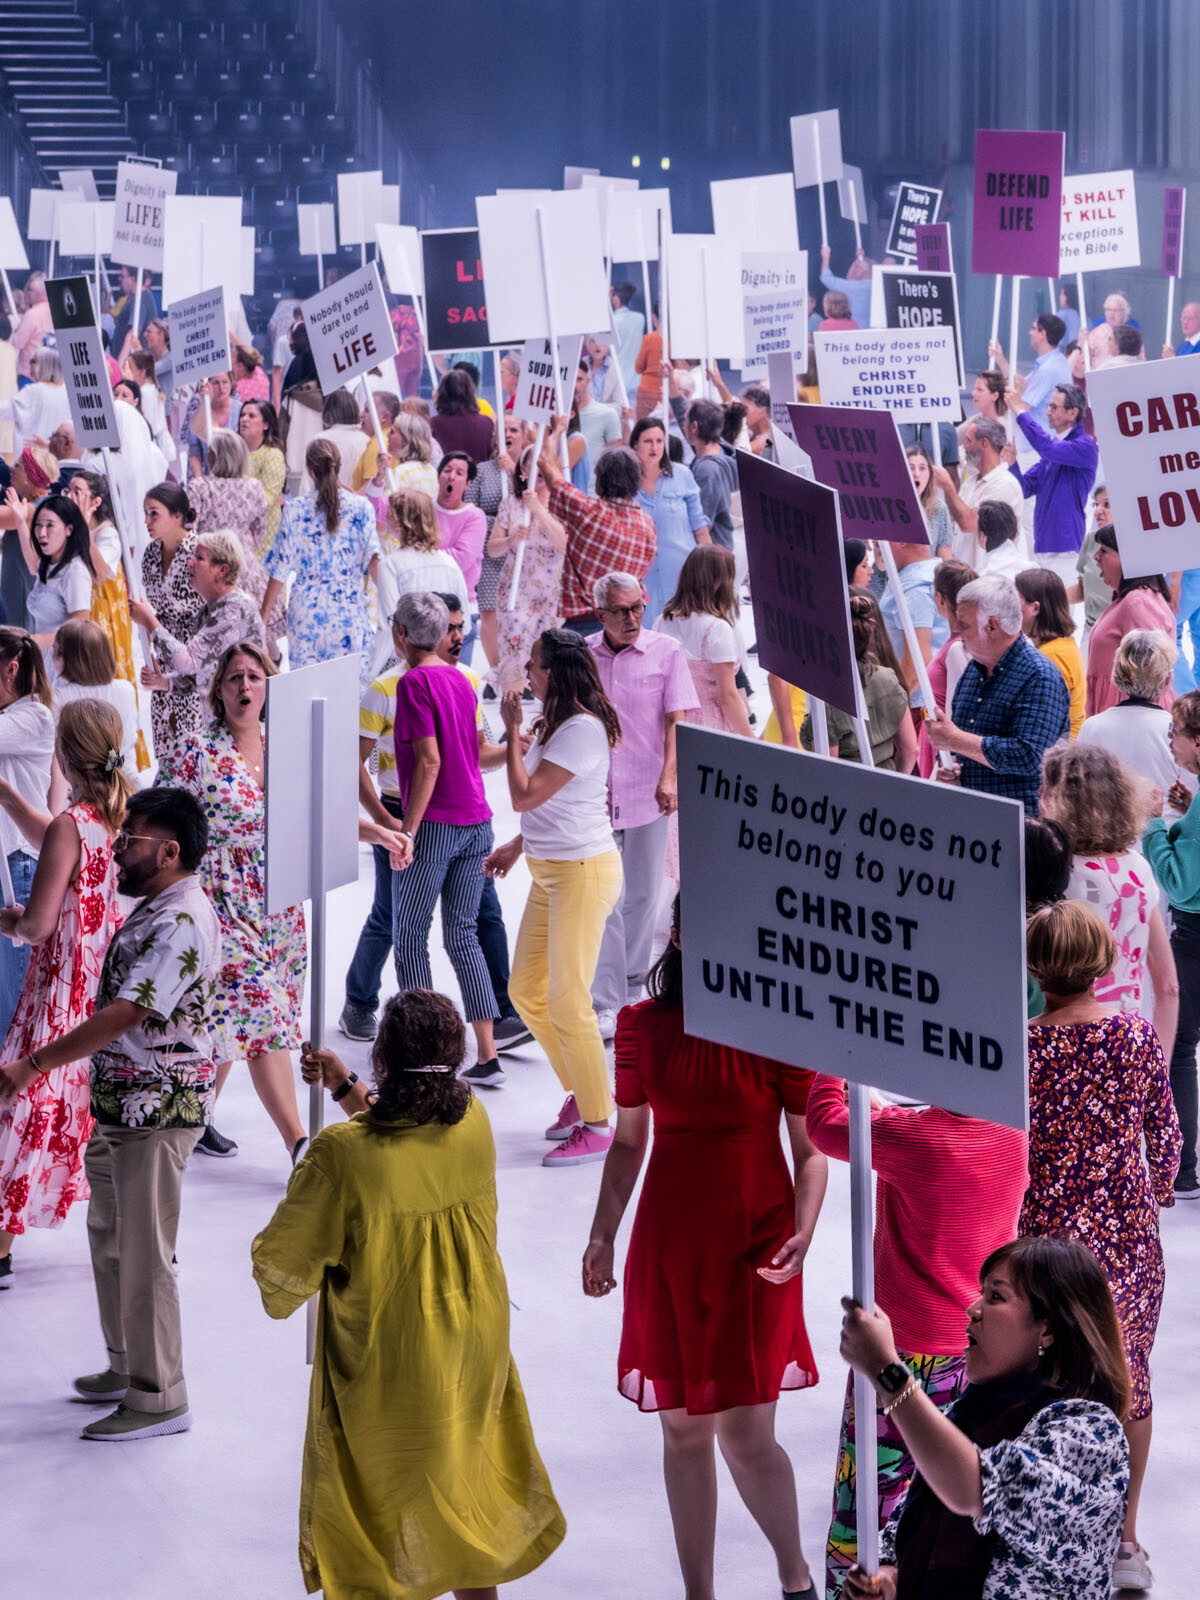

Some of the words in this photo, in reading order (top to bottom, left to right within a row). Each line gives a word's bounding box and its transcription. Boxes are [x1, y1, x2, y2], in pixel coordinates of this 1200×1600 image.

[124, 179, 156, 199] Dignity
[986, 172, 1049, 199] DEFEND
[1074, 189, 1126, 205] SHALT
[125, 201, 162, 228] LIFE
[901, 205, 928, 225] HOPE
[1000, 206, 1034, 232] LIFE
[1080, 208, 1116, 222] KILL
[1060, 226, 1124, 243] xceptions
[1086, 243, 1118, 255] Bible
[741, 269, 780, 288] Dignity
[785, 271, 796, 285] in
[898, 279, 938, 298] There's
[310, 301, 342, 325] Nobody
[344, 280, 374, 305] should
[322, 319, 340, 336] dare
[342, 312, 351, 323] to
[353, 300, 370, 317] end
[898, 306, 942, 328] HOPE
[186, 327, 209, 343] CHRIST
[339, 324, 359, 344] your
[760, 327, 787, 340] CHRIST
[70, 341, 90, 366] LIFE
[184, 339, 214, 358] ENDURED
[332, 332, 377, 374] LIFE
[756, 340, 791, 353] ENDURED
[824, 343, 849, 353] This
[855, 342, 885, 352] body
[891, 340, 920, 350] does
[926, 339, 946, 349] not
[176, 360, 195, 374] UNTIL
[197, 354, 210, 366] THE
[212, 349, 226, 361] END
[745, 357, 767, 368] UNTIL
[842, 355, 885, 366] belong
[890, 355, 902, 363] to
[907, 354, 930, 365] you
[73, 373, 81, 388] is
[81, 372, 88, 387] to
[88, 371, 98, 387] be
[859, 370, 916, 382] CHRIST
[853, 384, 926, 396] ENDURED
[76, 392, 95, 409] lived
[95, 395, 103, 409] to
[883, 398, 913, 409] THE
[920, 397, 952, 407] END
[81, 415, 94, 431] the
[94, 413, 108, 430] end
[814, 425, 878, 454] EVERY
[836, 460, 880, 488] LIFE
[840, 494, 911, 524] OUNTS
[759, 492, 817, 555] EVERY
[775, 553, 816, 610] LIFE
[763, 600, 841, 677] COUNTS
[697, 765, 758, 809] This
[772, 783, 847, 836] body
[859, 808, 934, 851] does
[949, 833, 1001, 867] not
[738, 820, 842, 880] belong
[856, 851, 884, 884] to
[898, 866, 955, 902] you
[776, 886, 918, 951] CHRIST
[758, 927, 940, 1005] ENDURED
[703, 959, 814, 1020] UNTIL
[829, 994, 904, 1046] THE
[923, 1020, 1003, 1072] END
